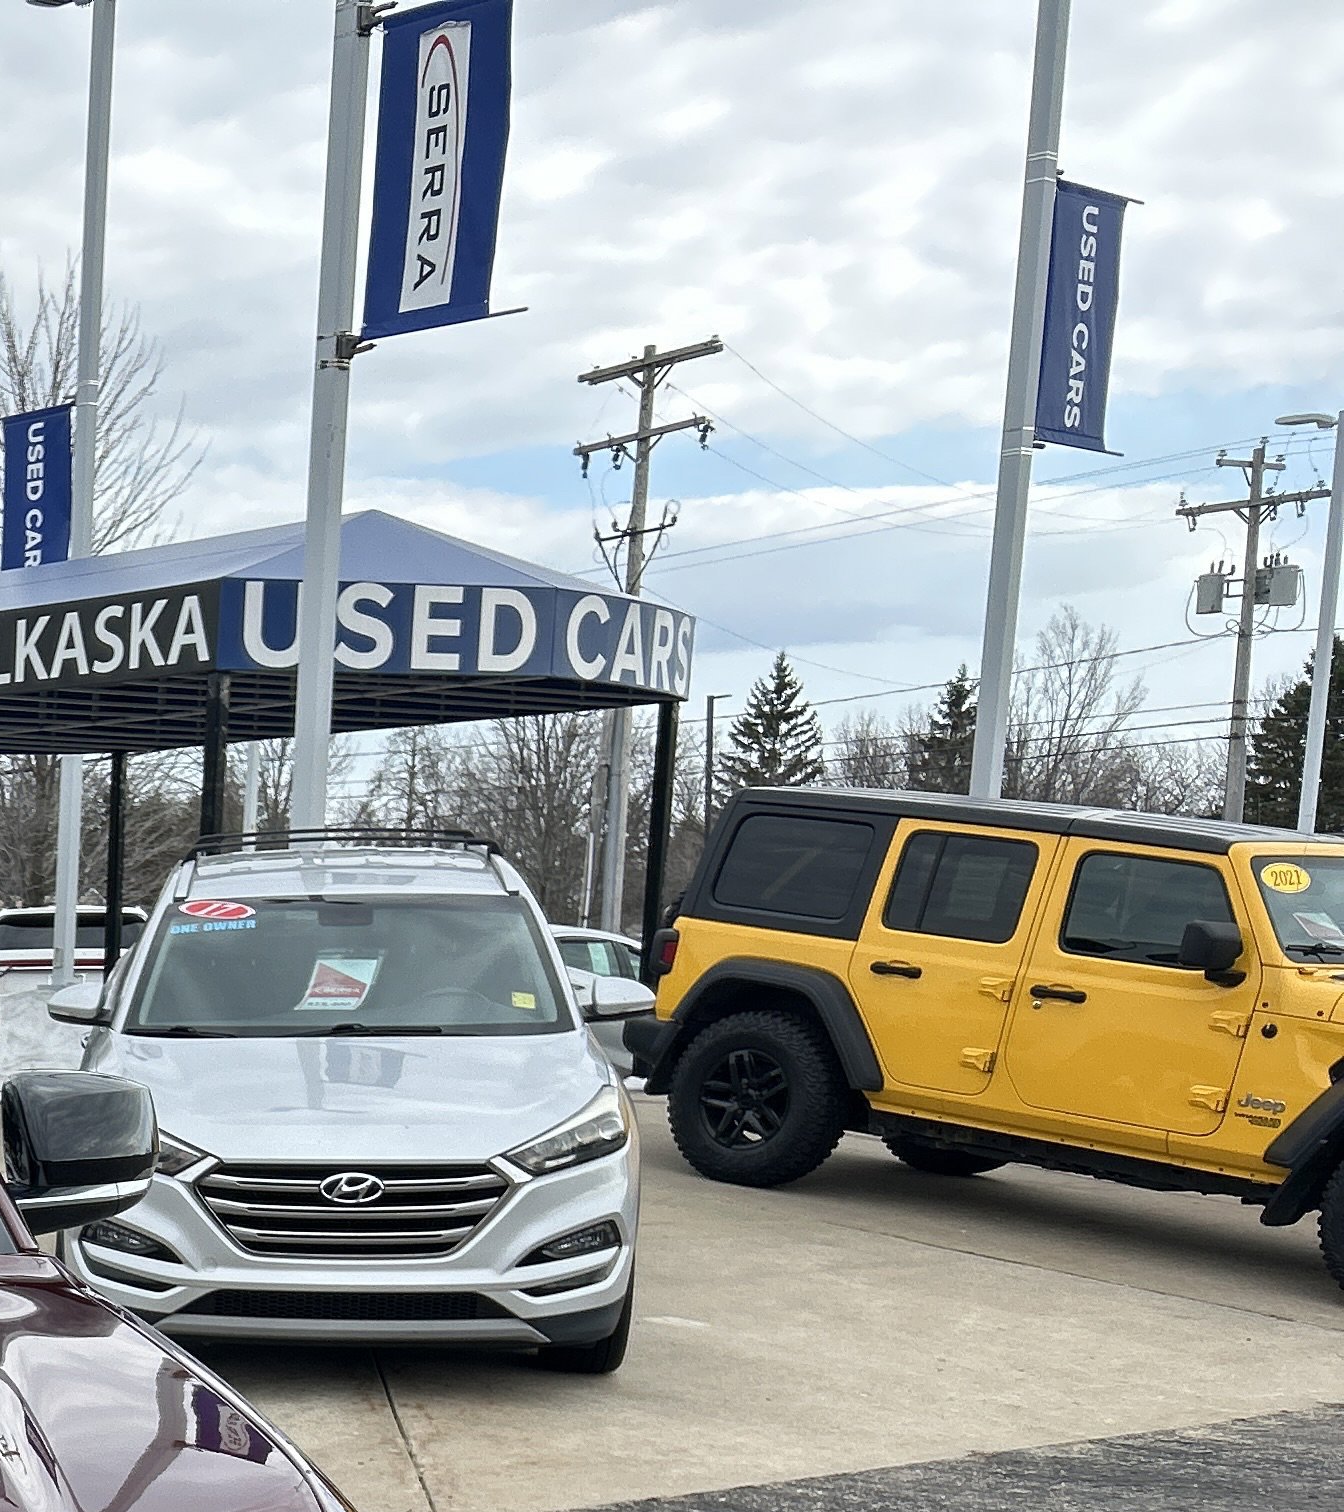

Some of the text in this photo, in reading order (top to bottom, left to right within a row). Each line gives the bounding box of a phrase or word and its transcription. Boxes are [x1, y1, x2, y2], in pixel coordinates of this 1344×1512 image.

[412, 83, 450, 291] SERRA
[1064, 205, 1099, 428] USED CARS
[24, 421, 45, 568] USED CAR
[243, 581, 691, 697] USED CARS
[170, 920, 256, 934] ONE OWNER
[1271, 870, 1302, 887] 2021
[1237, 1091, 1286, 1116] Jeep
